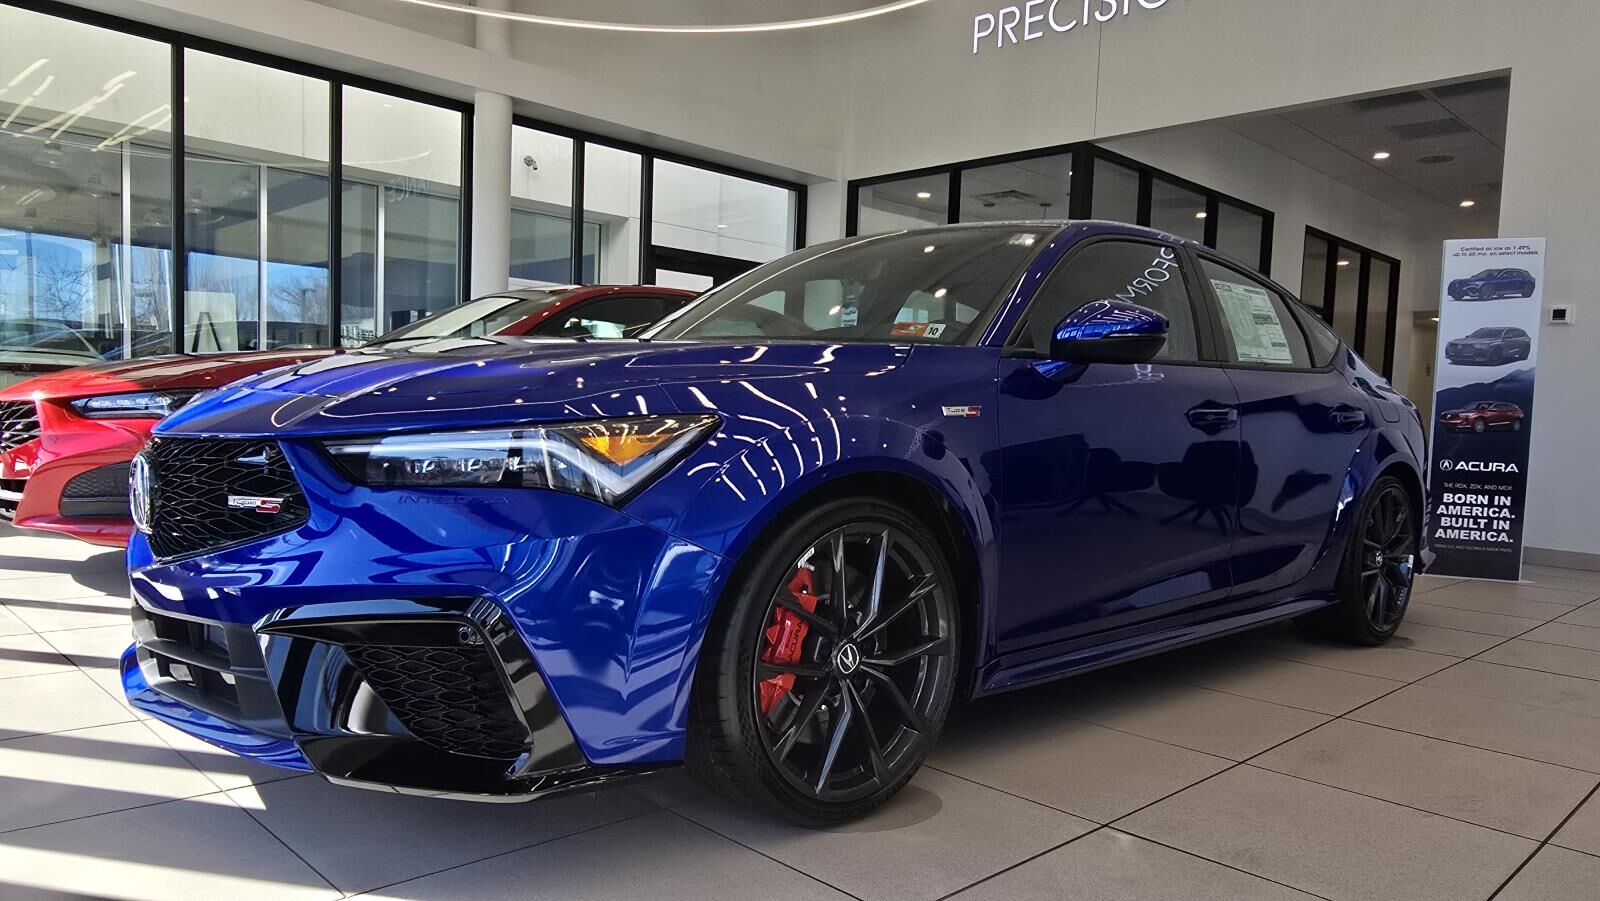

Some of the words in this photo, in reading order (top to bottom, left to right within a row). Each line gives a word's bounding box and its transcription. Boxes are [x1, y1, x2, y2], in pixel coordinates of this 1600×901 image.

[973, 0, 1168, 54] PRECIS
[928, 327, 939, 336] 10
[1455, 461, 1519, 472] ACURA
[1443, 493, 1489, 505] BORN
[1494, 496, 1511, 506] IN
[1436, 505, 1516, 519] AMERICA.
[1440, 517, 1488, 529] BUILT
[1493, 520, 1510, 531] IN
[1435, 529, 1514, 543] AMERICA.
[788, 621, 802, 661] ACURA
